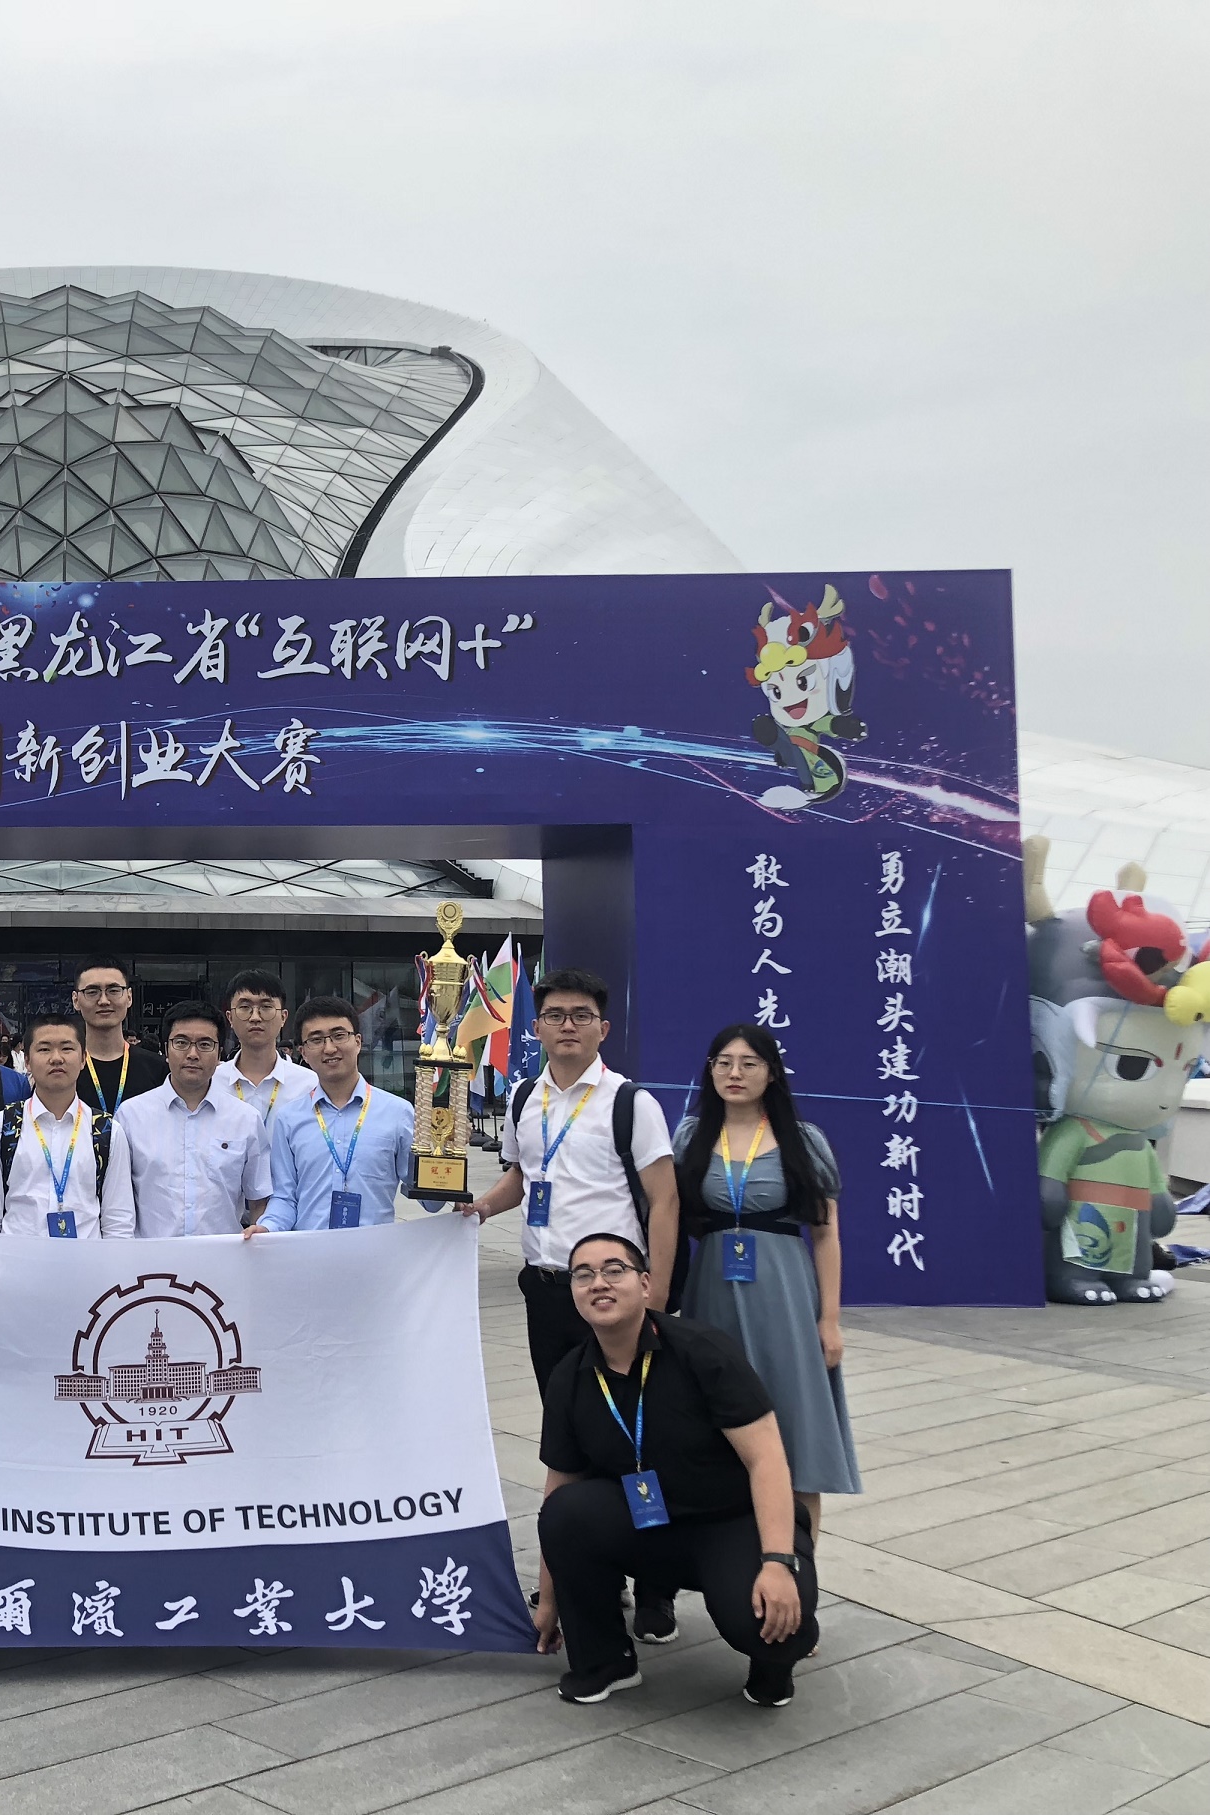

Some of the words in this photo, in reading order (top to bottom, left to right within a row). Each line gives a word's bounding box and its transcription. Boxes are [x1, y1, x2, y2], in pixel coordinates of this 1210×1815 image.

[746, 852, 795, 1075] 敢为人先
[874, 851, 925, 1271] 勇立潮头建功新时代
[126, 1427, 190, 1443] HIT
[138, 1404, 178, 1417] 1920
[2, 1507, 171, 1536] INSTITUTE
[183, 1507, 225, 1534] OF
[235, 1487, 464, 1530] TECHNOLOGY
